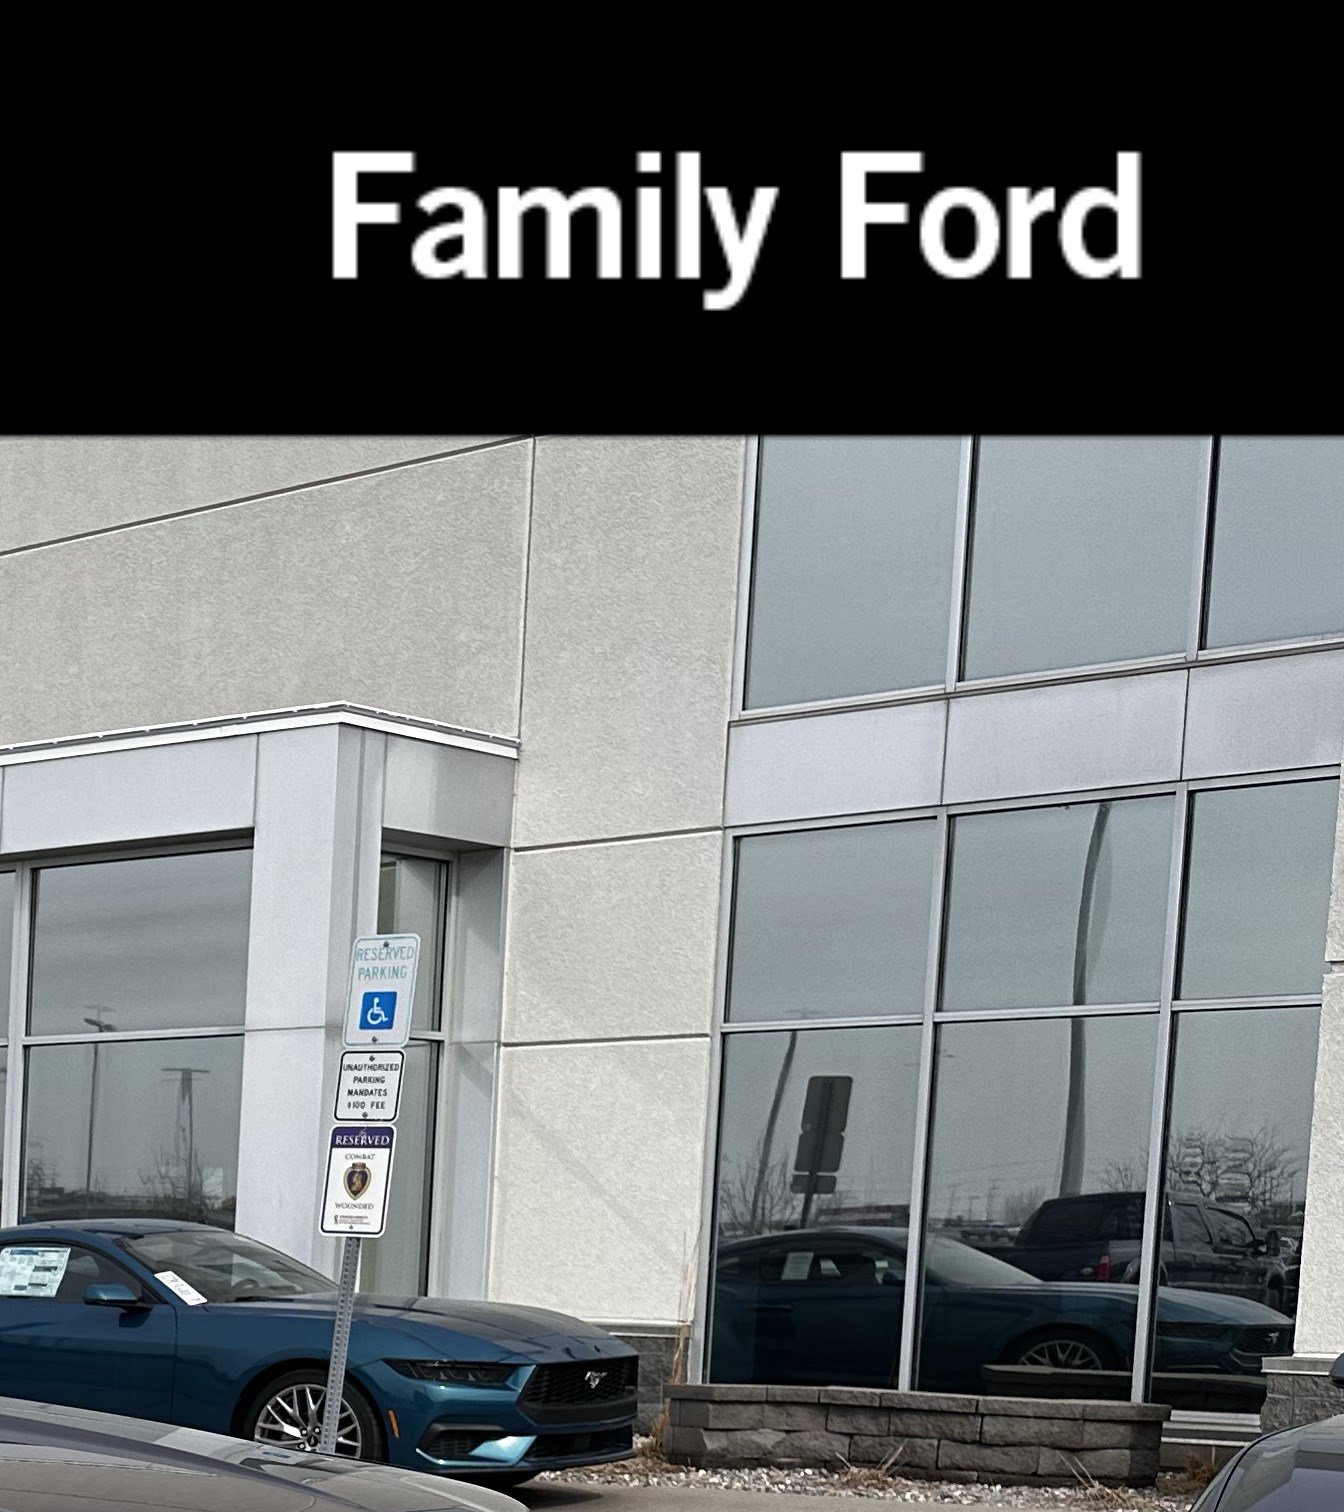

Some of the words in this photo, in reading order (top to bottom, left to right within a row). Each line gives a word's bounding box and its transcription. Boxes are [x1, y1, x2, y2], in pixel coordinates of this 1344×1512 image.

[355, 945, 414, 962] RESERVED
[358, 965, 407, 981] PARKING
[343, 1063, 400, 1072] UNAUTHORIZED
[353, 1075, 386, 1084] PARKING
[347, 1088, 388, 1097] MANDATES
[370, 1101, 386, 1109] FEE
[335, 1134, 391, 1146] RESERVED
